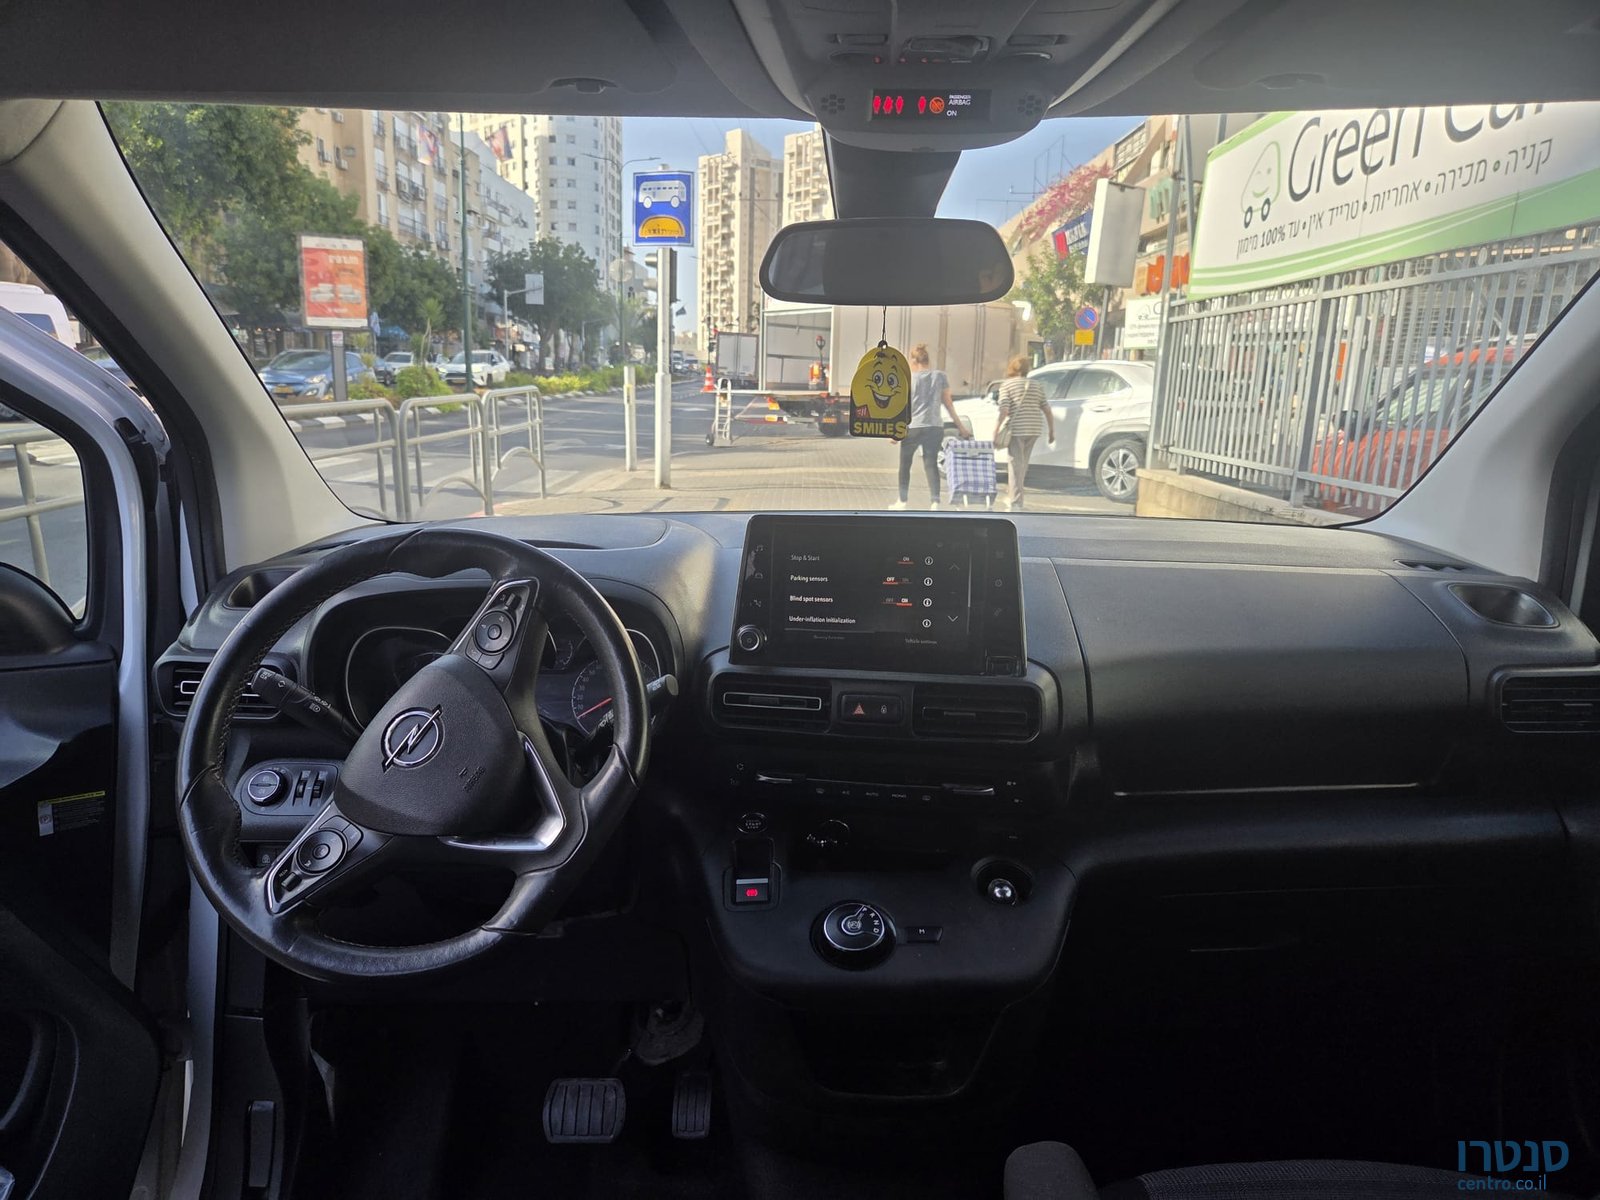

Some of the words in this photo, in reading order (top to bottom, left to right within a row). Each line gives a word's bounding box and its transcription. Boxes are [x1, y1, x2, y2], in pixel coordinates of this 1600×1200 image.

[1288, 106, 1426, 202] Green
[1505, 138, 1553, 175] קניה
[1434, 158, 1488, 195] מכירה
[1370, 179, 1422, 214] אחריות
[1260, 224, 1286, 248] 100%
[854, 420, 907, 439] SMILES
[789, 575, 808, 583] Parking
[803, 596, 814, 604] spot
[788, 615, 826, 623] Under-inflation
[826, 616, 856, 624] initialization
